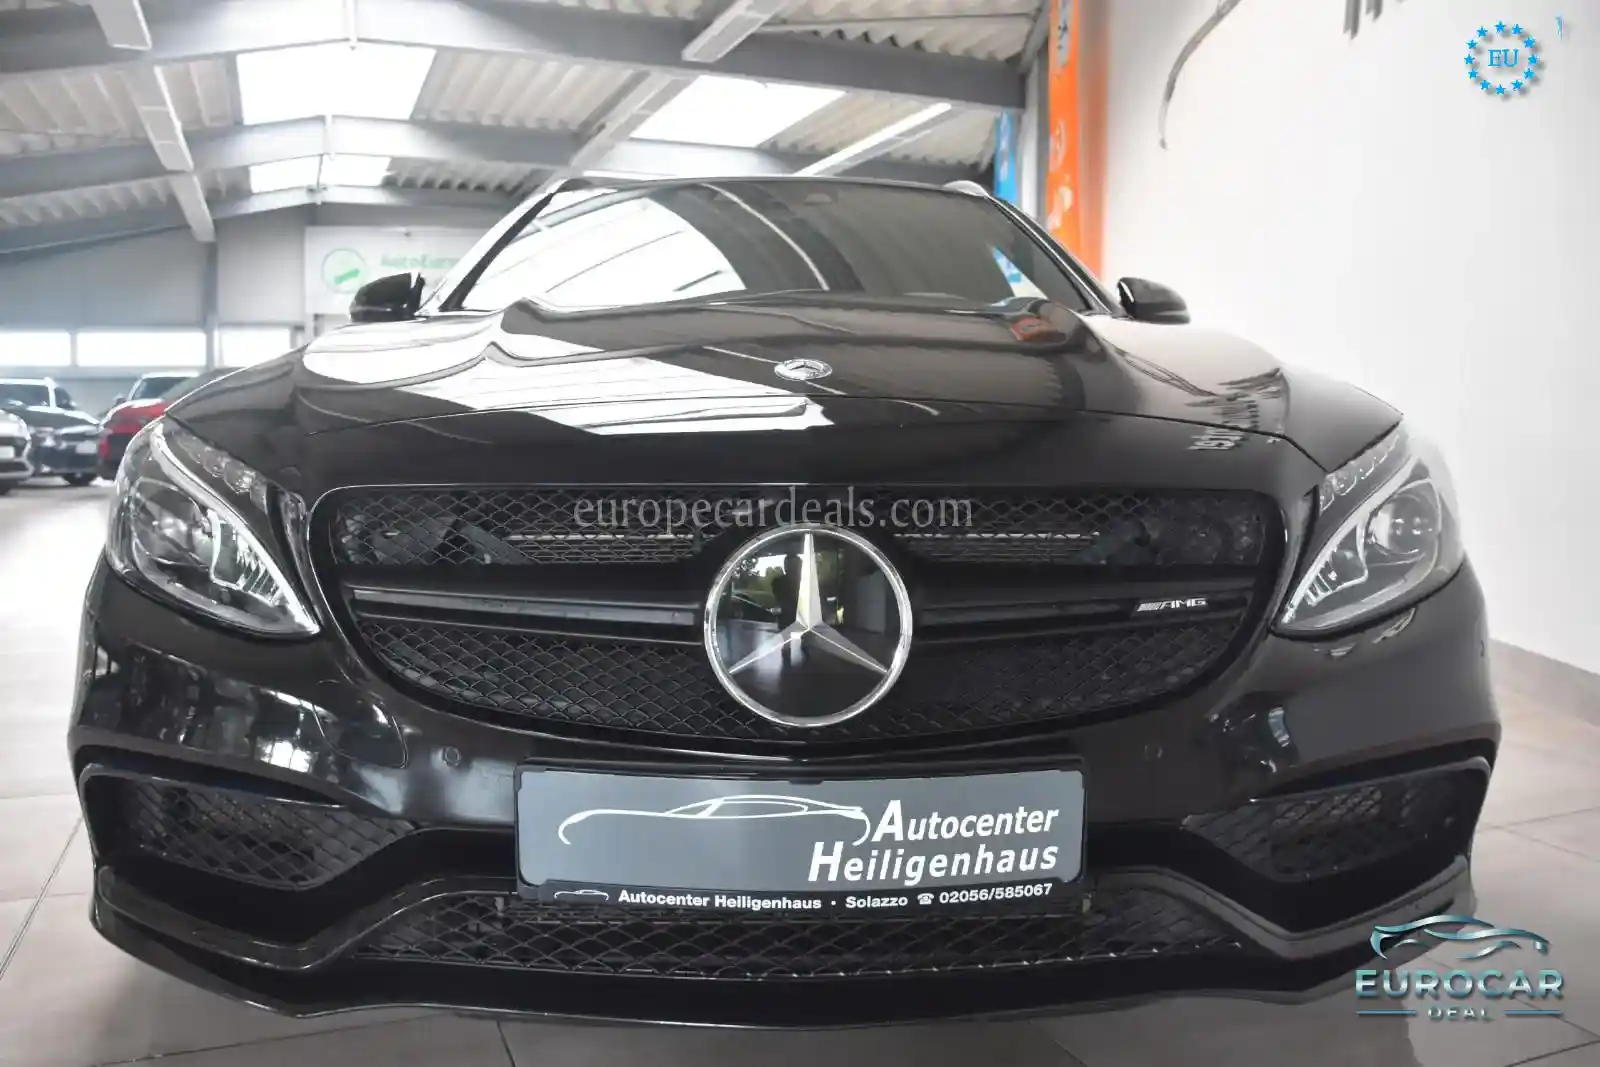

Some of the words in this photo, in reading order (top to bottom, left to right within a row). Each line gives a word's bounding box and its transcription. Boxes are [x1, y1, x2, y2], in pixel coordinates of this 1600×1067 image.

[871, 799, 1060, 842] Autocenter
[807, 840, 1059, 887] Heiligenhaus
[618, 889, 711, 908] Autocenter
[714, 894, 823, 912] Heiligenhaus
[845, 895, 908, 909] Solazzo
[938, 882, 1053, 904] 02056/585067
